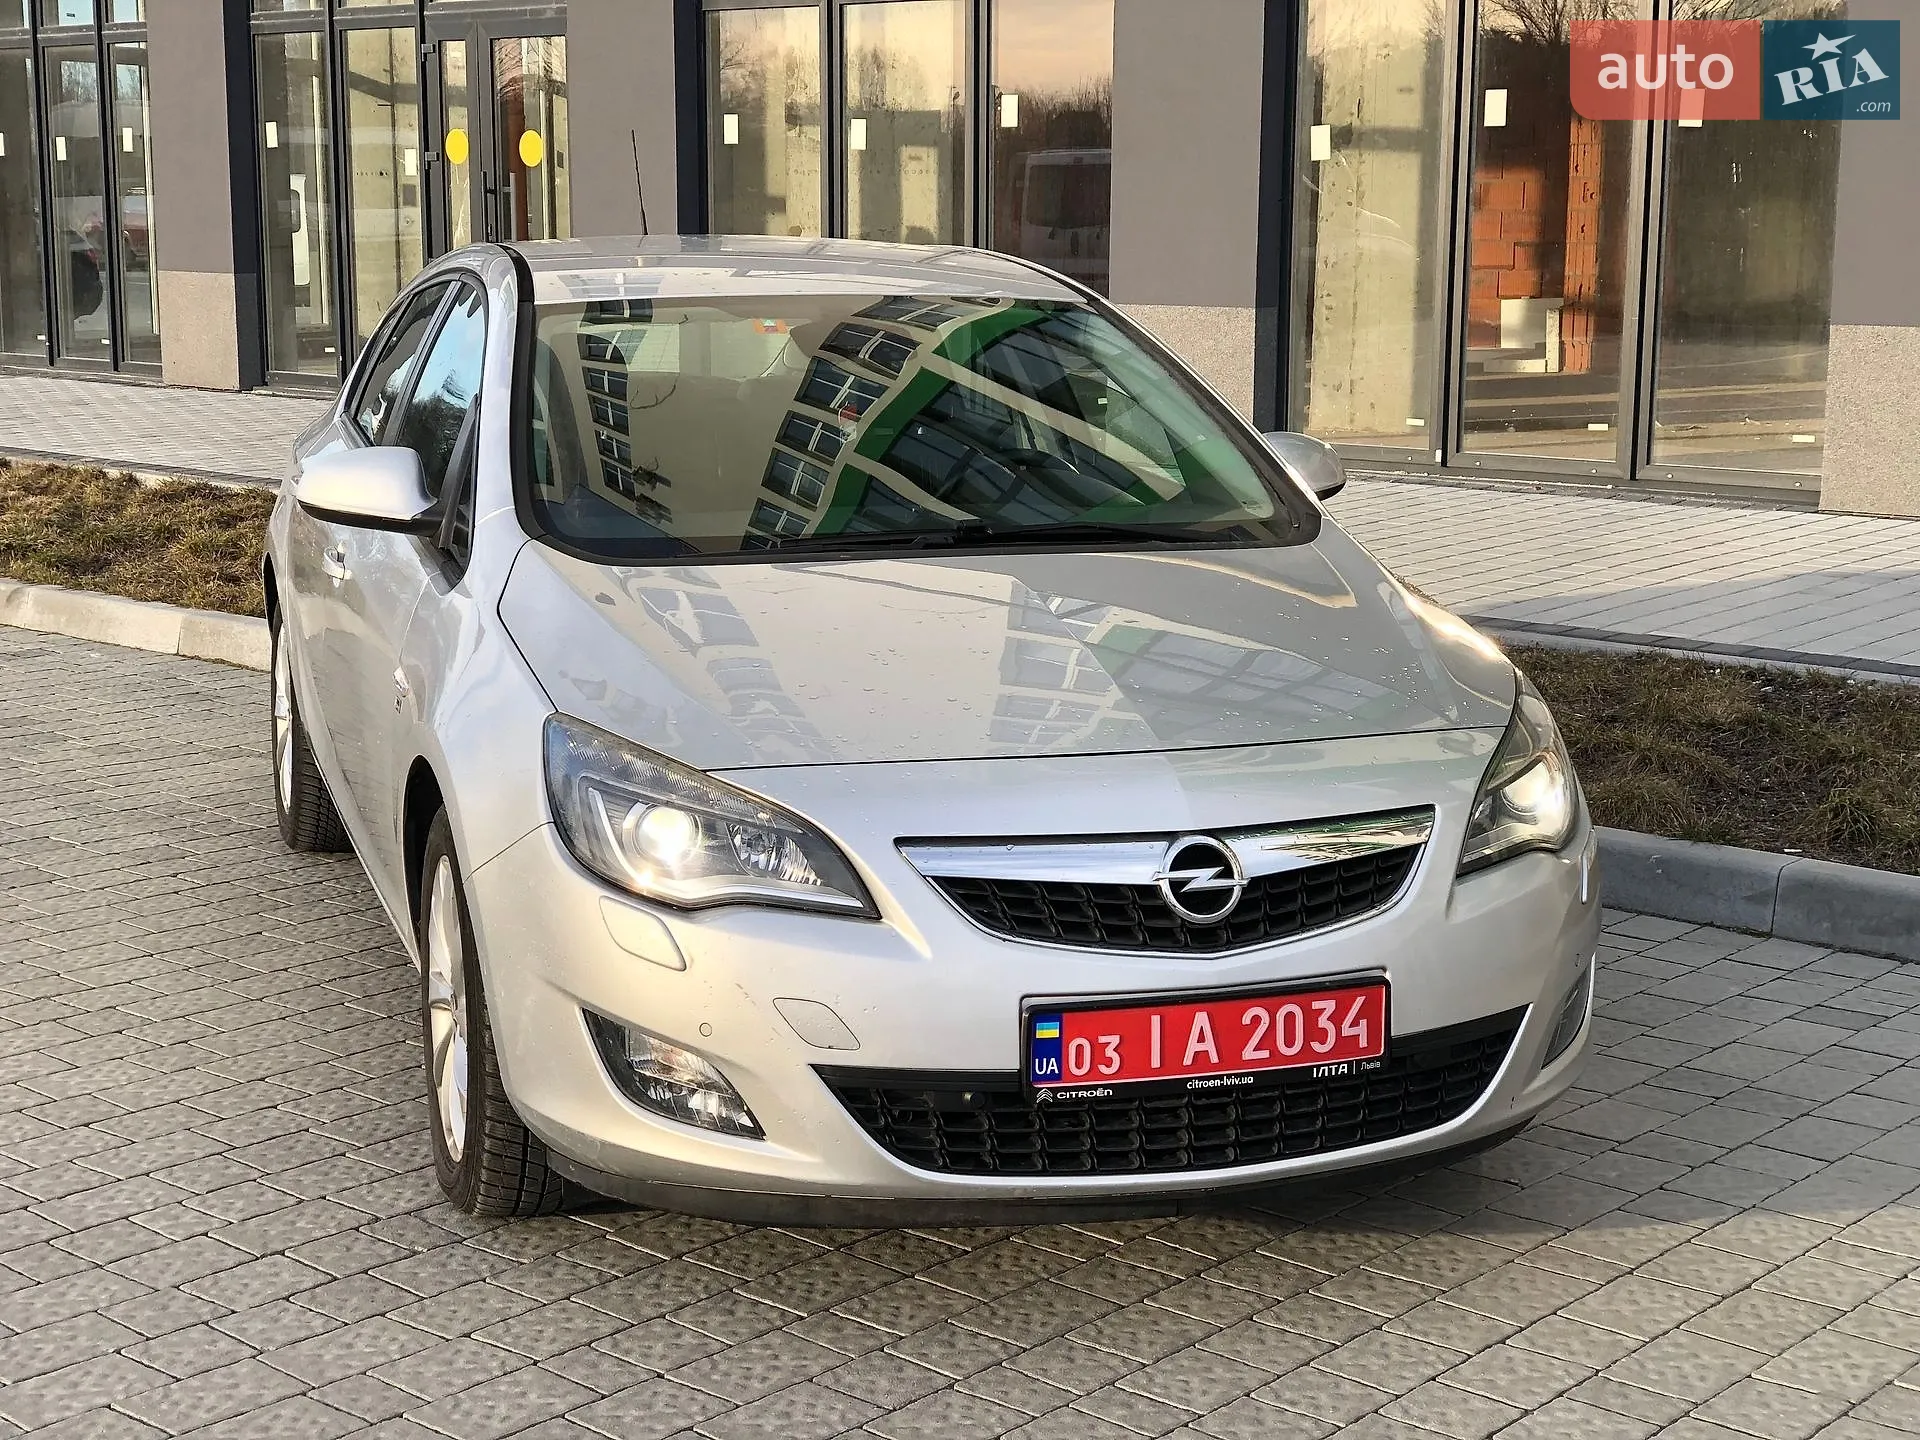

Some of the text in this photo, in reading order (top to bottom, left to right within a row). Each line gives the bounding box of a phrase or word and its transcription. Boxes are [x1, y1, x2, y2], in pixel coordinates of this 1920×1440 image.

[1067, 1034, 1121, 1076] 03
[1241, 995, 1368, 1061] 2034
[1035, 1058, 1059, 1075] UA
[1360, 1060, 1381, 1071] Львів
[1186, 1075, 1254, 1090] citroen-lviv.ua
